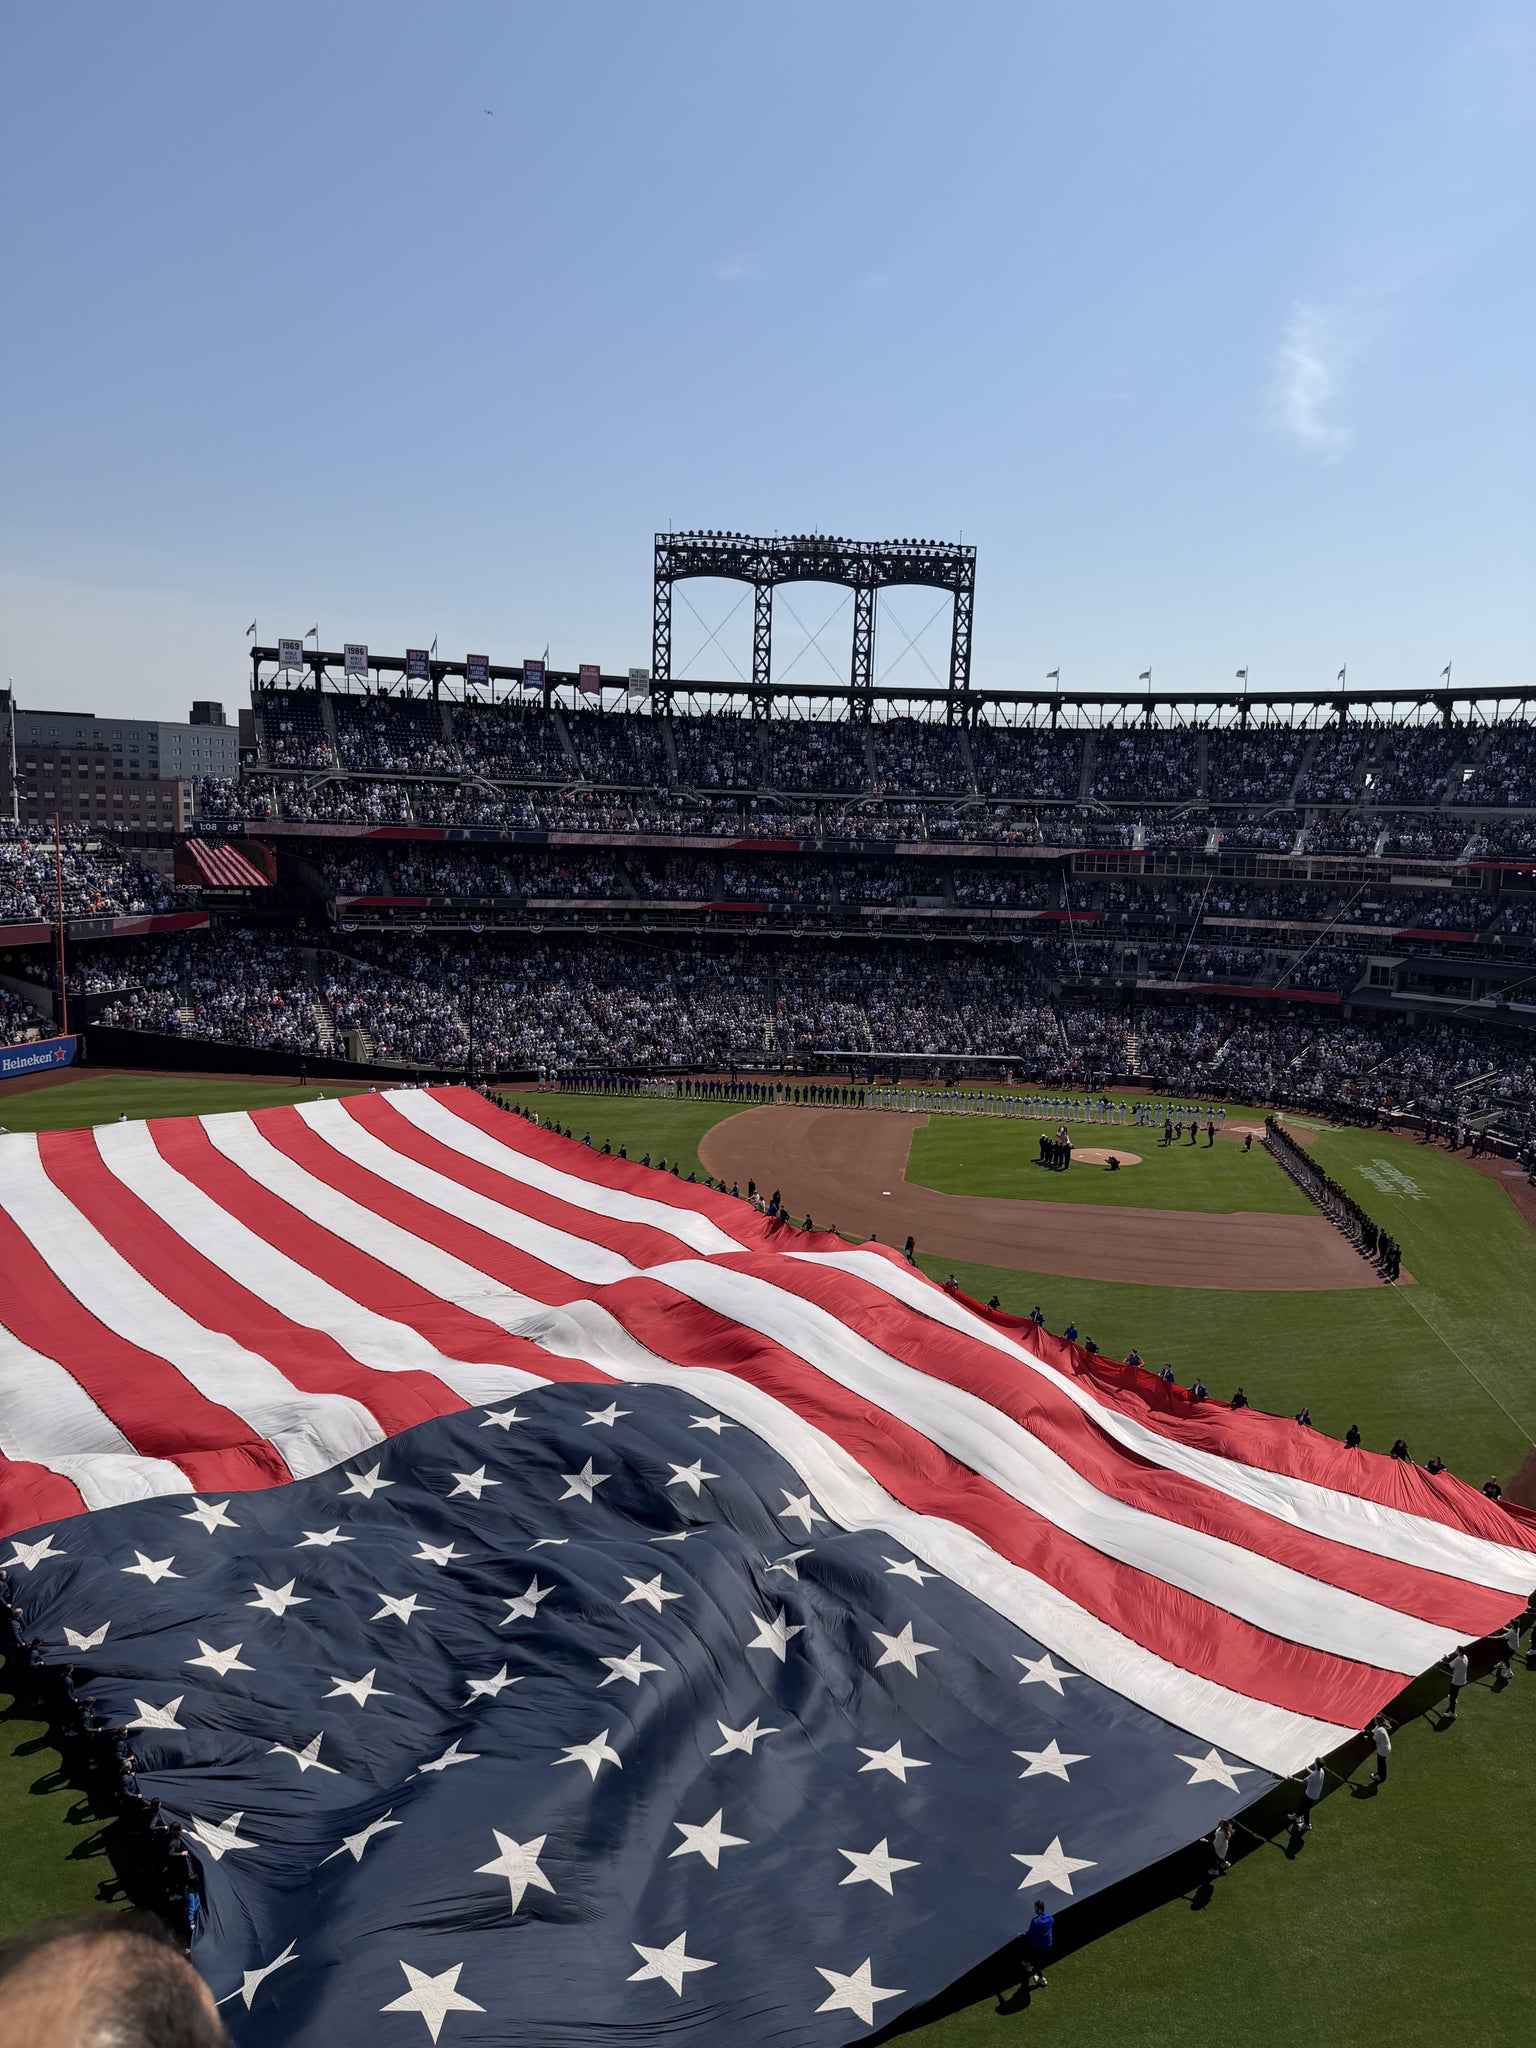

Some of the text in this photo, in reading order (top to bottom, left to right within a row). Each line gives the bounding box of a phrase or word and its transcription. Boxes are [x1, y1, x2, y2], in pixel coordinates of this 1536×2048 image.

[282, 642, 300, 650] 1969
[347, 647, 365, 656] 1986
[468, 656, 487, 665] 2000
[199, 823, 217, 831] 1:08
[2, 1053, 53, 1071] Heineken
